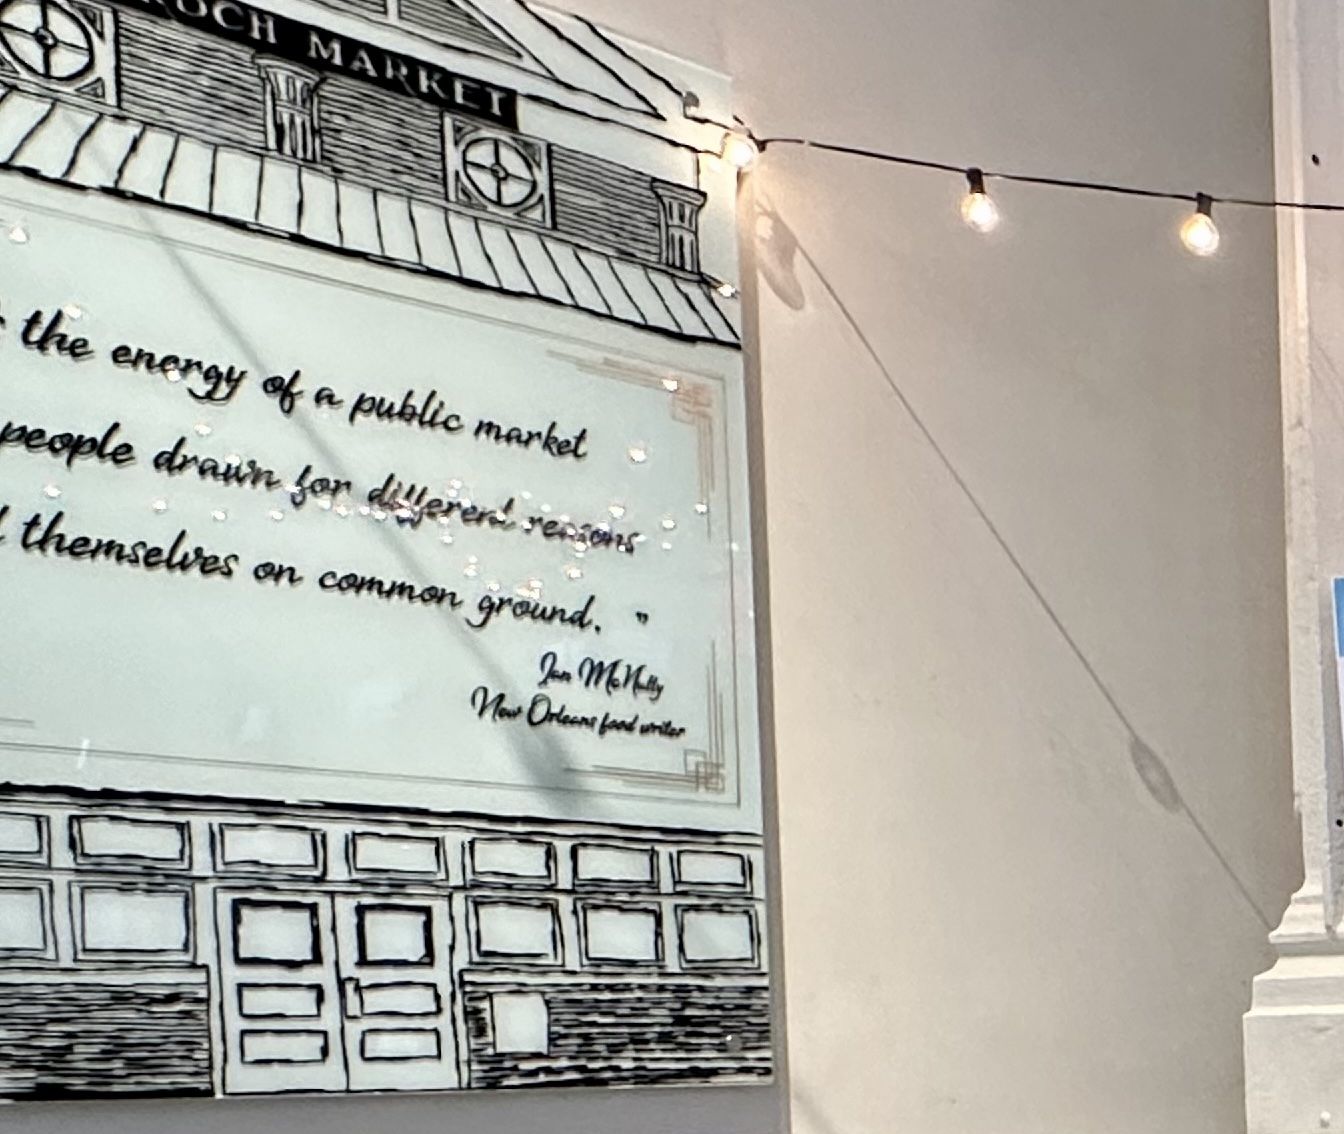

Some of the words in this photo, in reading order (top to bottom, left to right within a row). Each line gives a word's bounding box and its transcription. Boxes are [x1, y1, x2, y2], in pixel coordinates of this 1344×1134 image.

[308, 32, 510, 117] MARKET
[21, 309, 94, 356] the
[112, 344, 247, 402] energy
[262, 369, 303, 414] of
[315, 386, 343, 407] a
[350, 389, 464, 432] public
[474, 421, 588, 459] market
[153, 436, 280, 488] drawn
[292, 464, 352, 508] for
[368, 473, 517, 529] different
[523, 512, 642, 554] reasons
[21, 510, 239, 577] themselves
[253, 560, 303, 587] on
[319, 568, 462, 608] common
[465, 594, 602, 634] ground.
[471, 685, 523, 722] New
[527, 693, 597, 726] Orleans
[599, 712, 639, 735] food
[639, 720, 686, 737] writer
